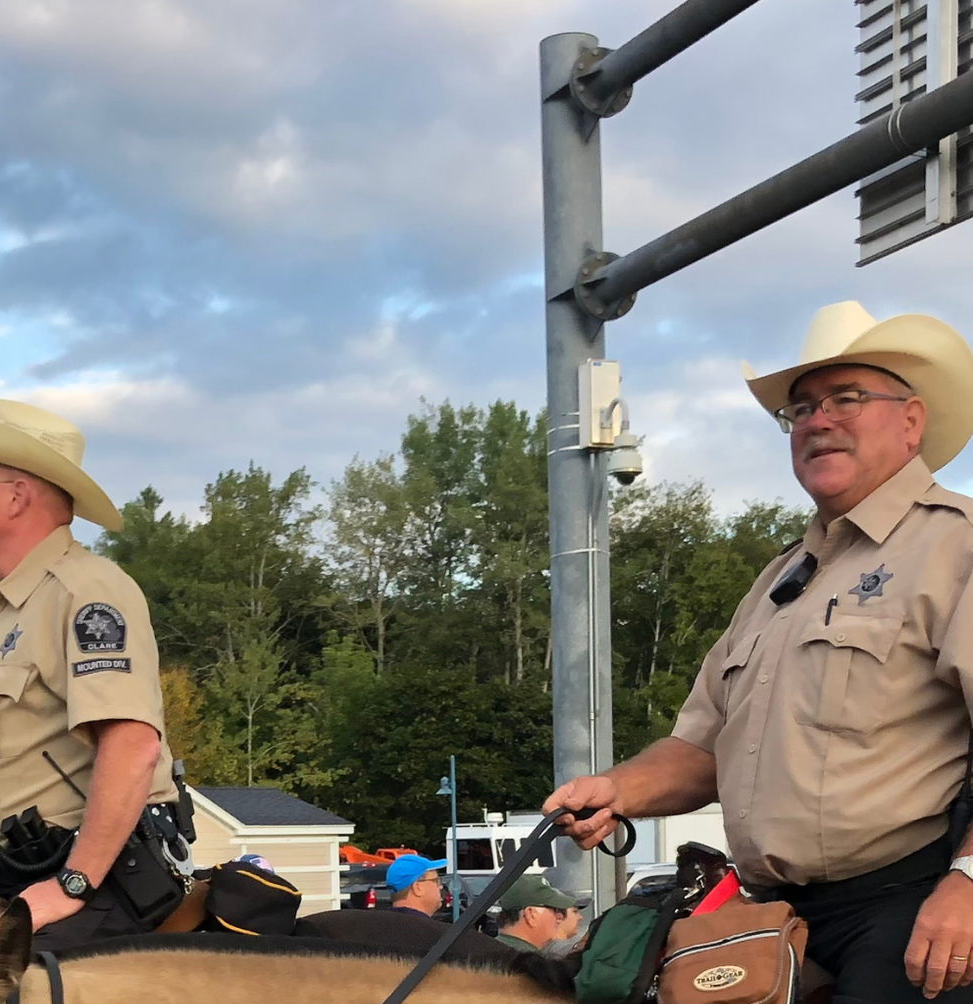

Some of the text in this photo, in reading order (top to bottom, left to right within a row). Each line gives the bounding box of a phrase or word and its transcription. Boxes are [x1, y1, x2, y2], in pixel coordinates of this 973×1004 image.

[77, 661, 112, 672] MOUNTED
[696, 970, 743, 984] TRAIL GEAR
